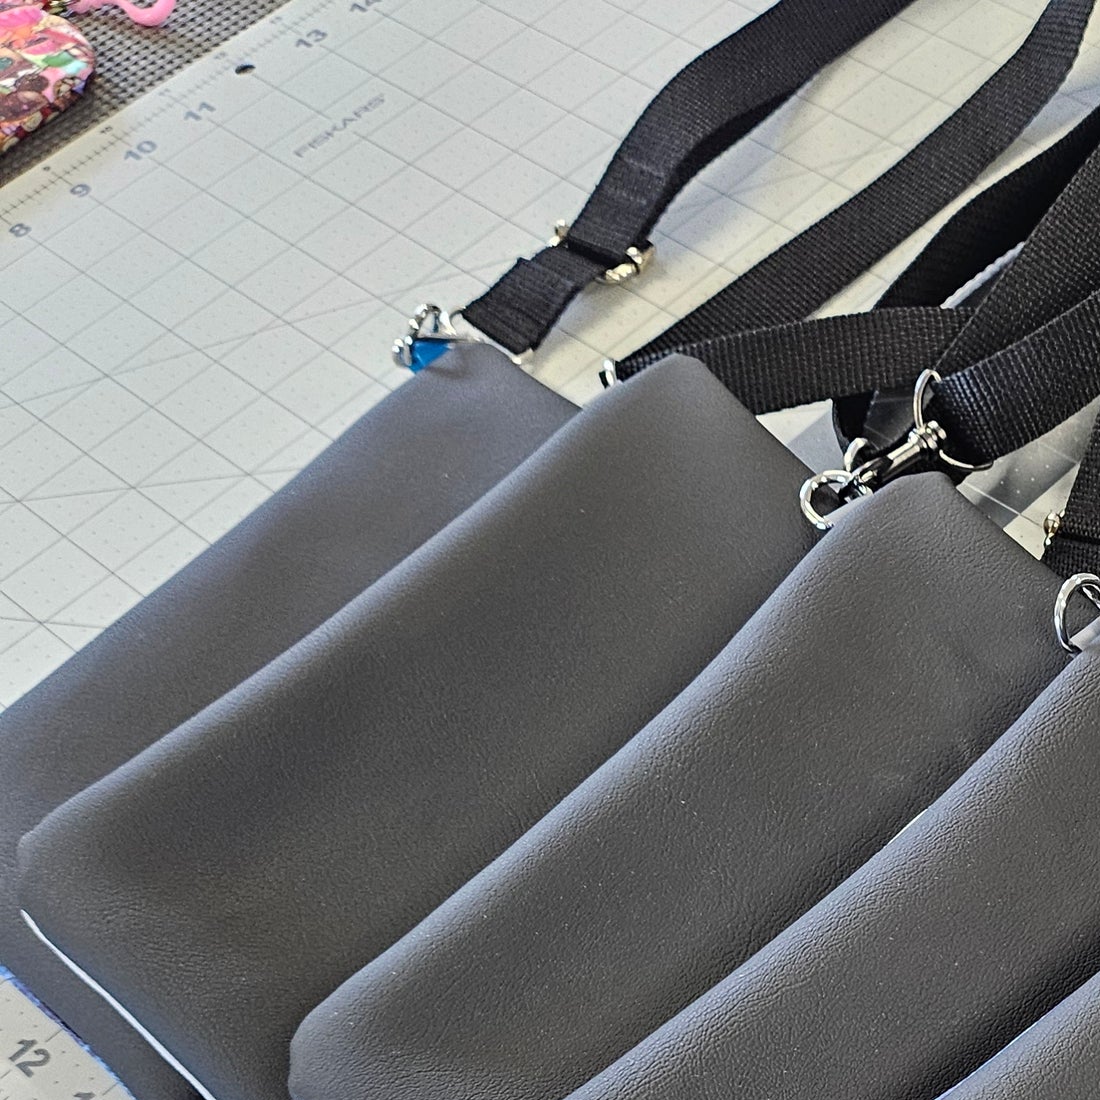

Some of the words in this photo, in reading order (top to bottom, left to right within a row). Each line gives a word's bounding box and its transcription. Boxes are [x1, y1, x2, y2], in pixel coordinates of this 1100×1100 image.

[8, 222, 32, 238] 8
[69, 183, 92, 198] 9
[123, 140, 158, 161] 10
[183, 101, 217, 122] 11
[295, 28, 328, 48] 13
[293, 93, 385, 158] FISKARS
[8, 1038, 52, 1079] 12
